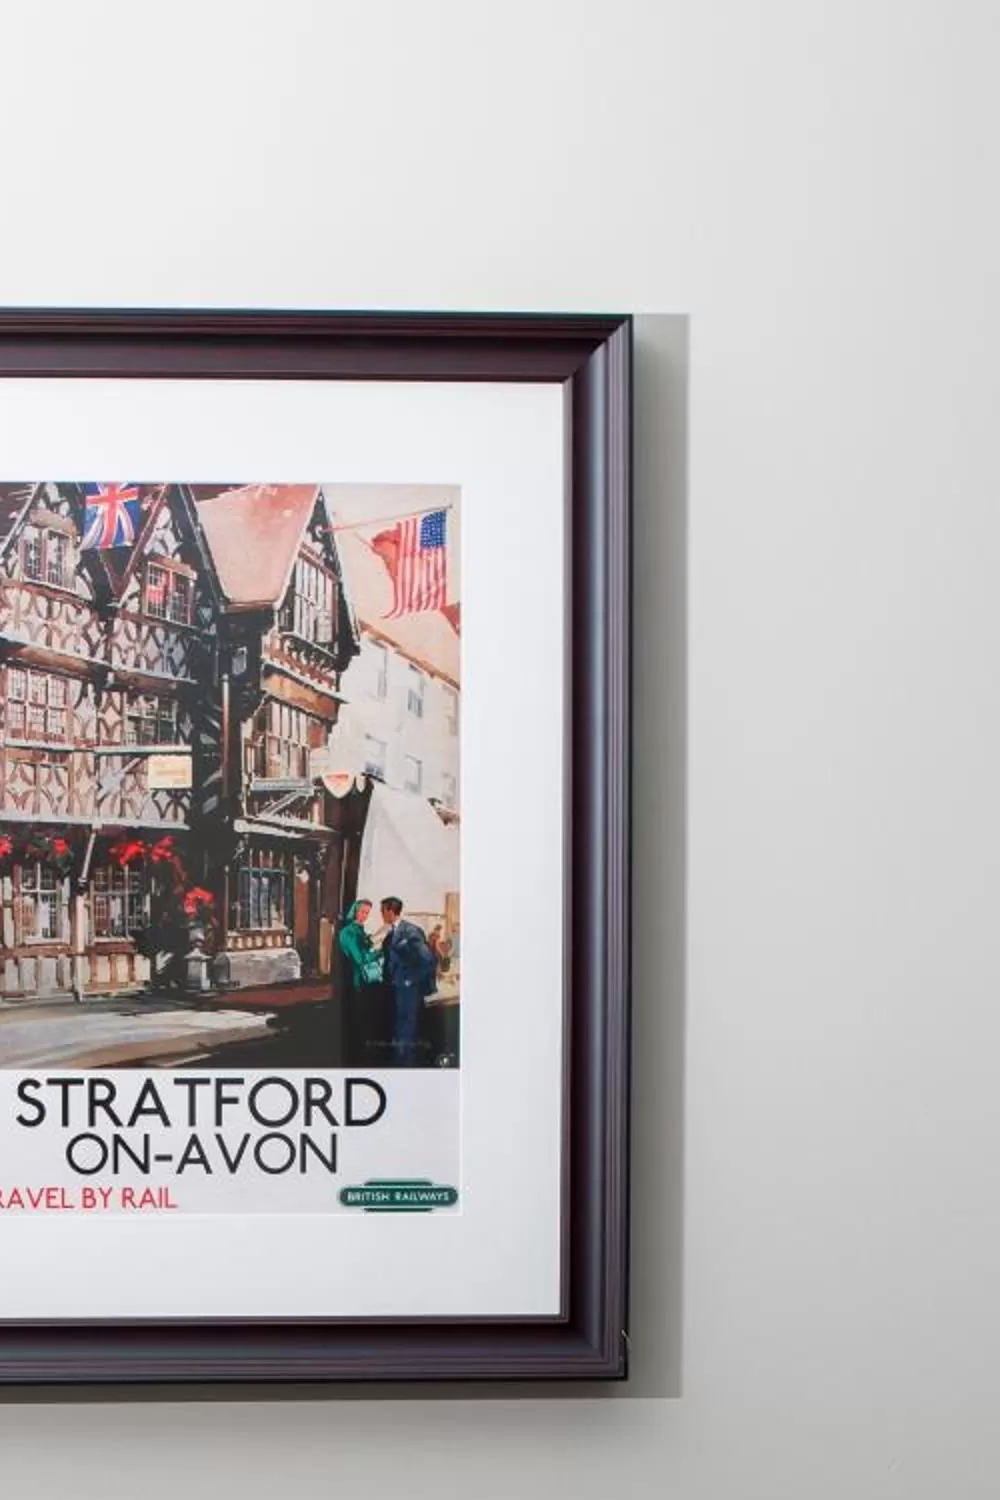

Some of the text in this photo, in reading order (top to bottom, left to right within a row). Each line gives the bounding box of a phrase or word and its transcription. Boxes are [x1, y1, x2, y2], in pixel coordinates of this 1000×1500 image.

[16, 1077, 387, 1128] STRATFORD
[66, 1132, 338, 1175] ON-AVON
[82, 1187, 113, 1208] BY
[121, 1187, 178, 1209] RAIL
[347, 1191, 449, 1201] BRITISH RAILWAYS
